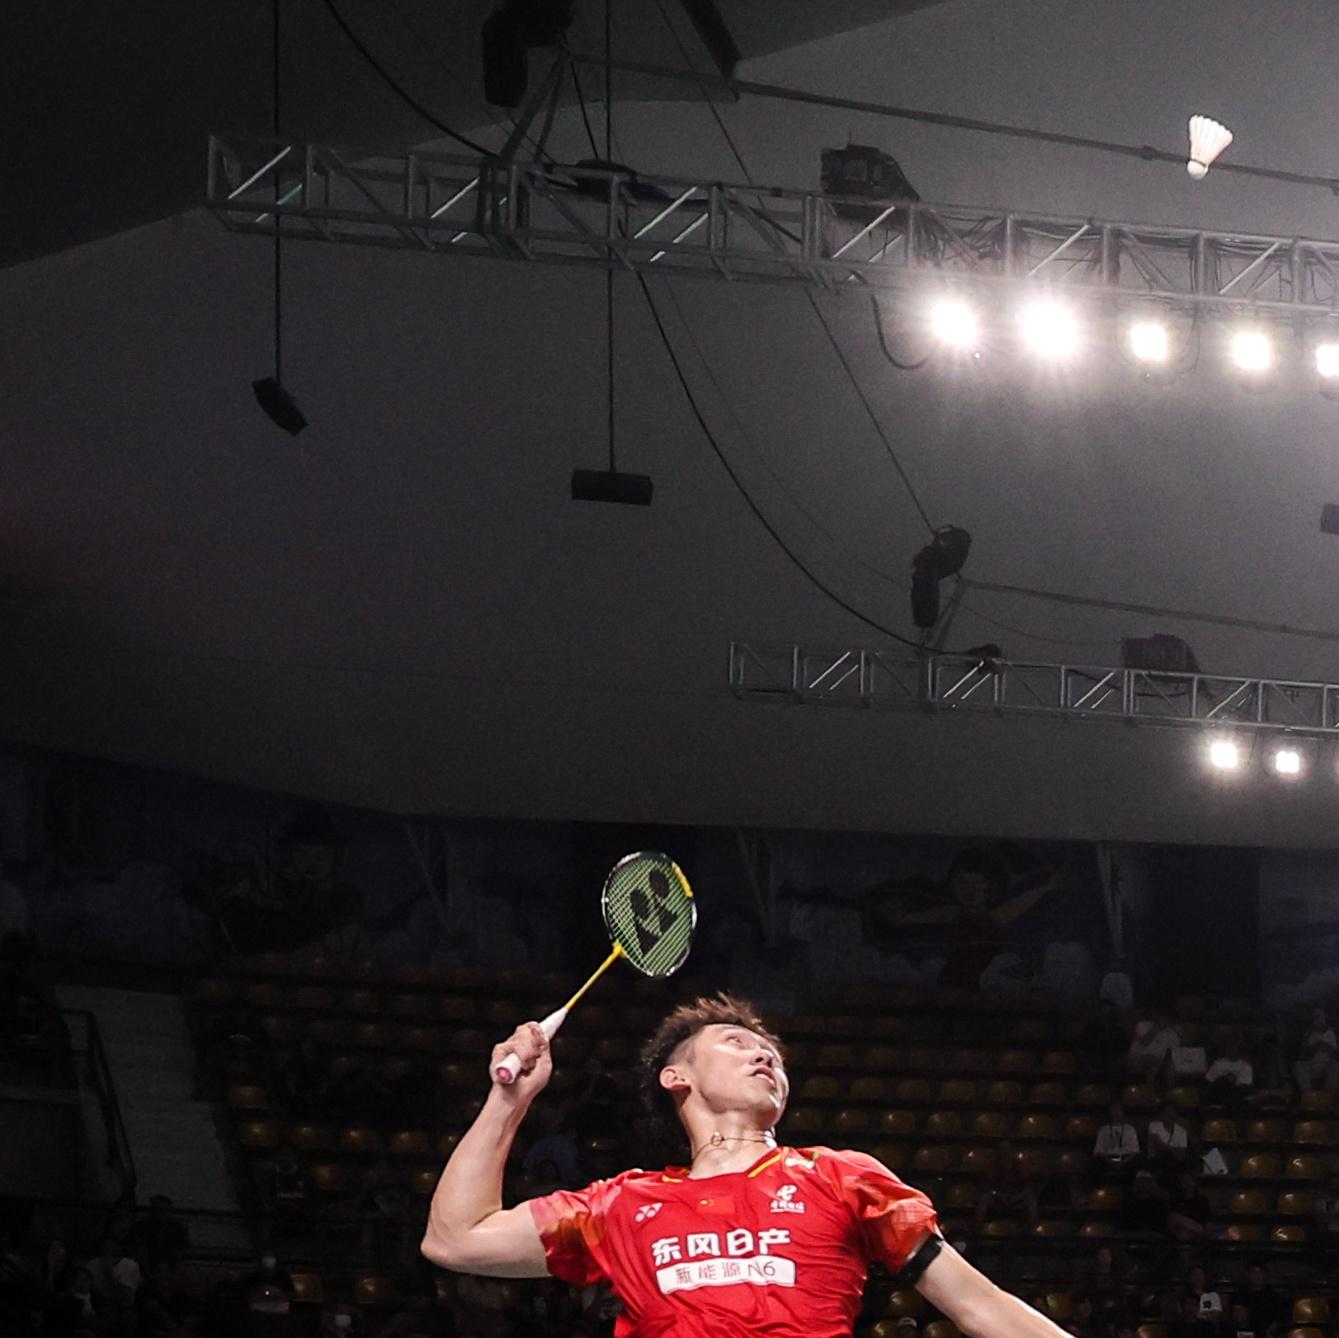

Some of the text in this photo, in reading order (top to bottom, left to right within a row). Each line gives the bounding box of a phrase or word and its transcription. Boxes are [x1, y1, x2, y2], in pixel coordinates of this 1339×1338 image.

[652, 1228, 792, 1266] 东风日产
[748, 1261, 777, 1277] N6
